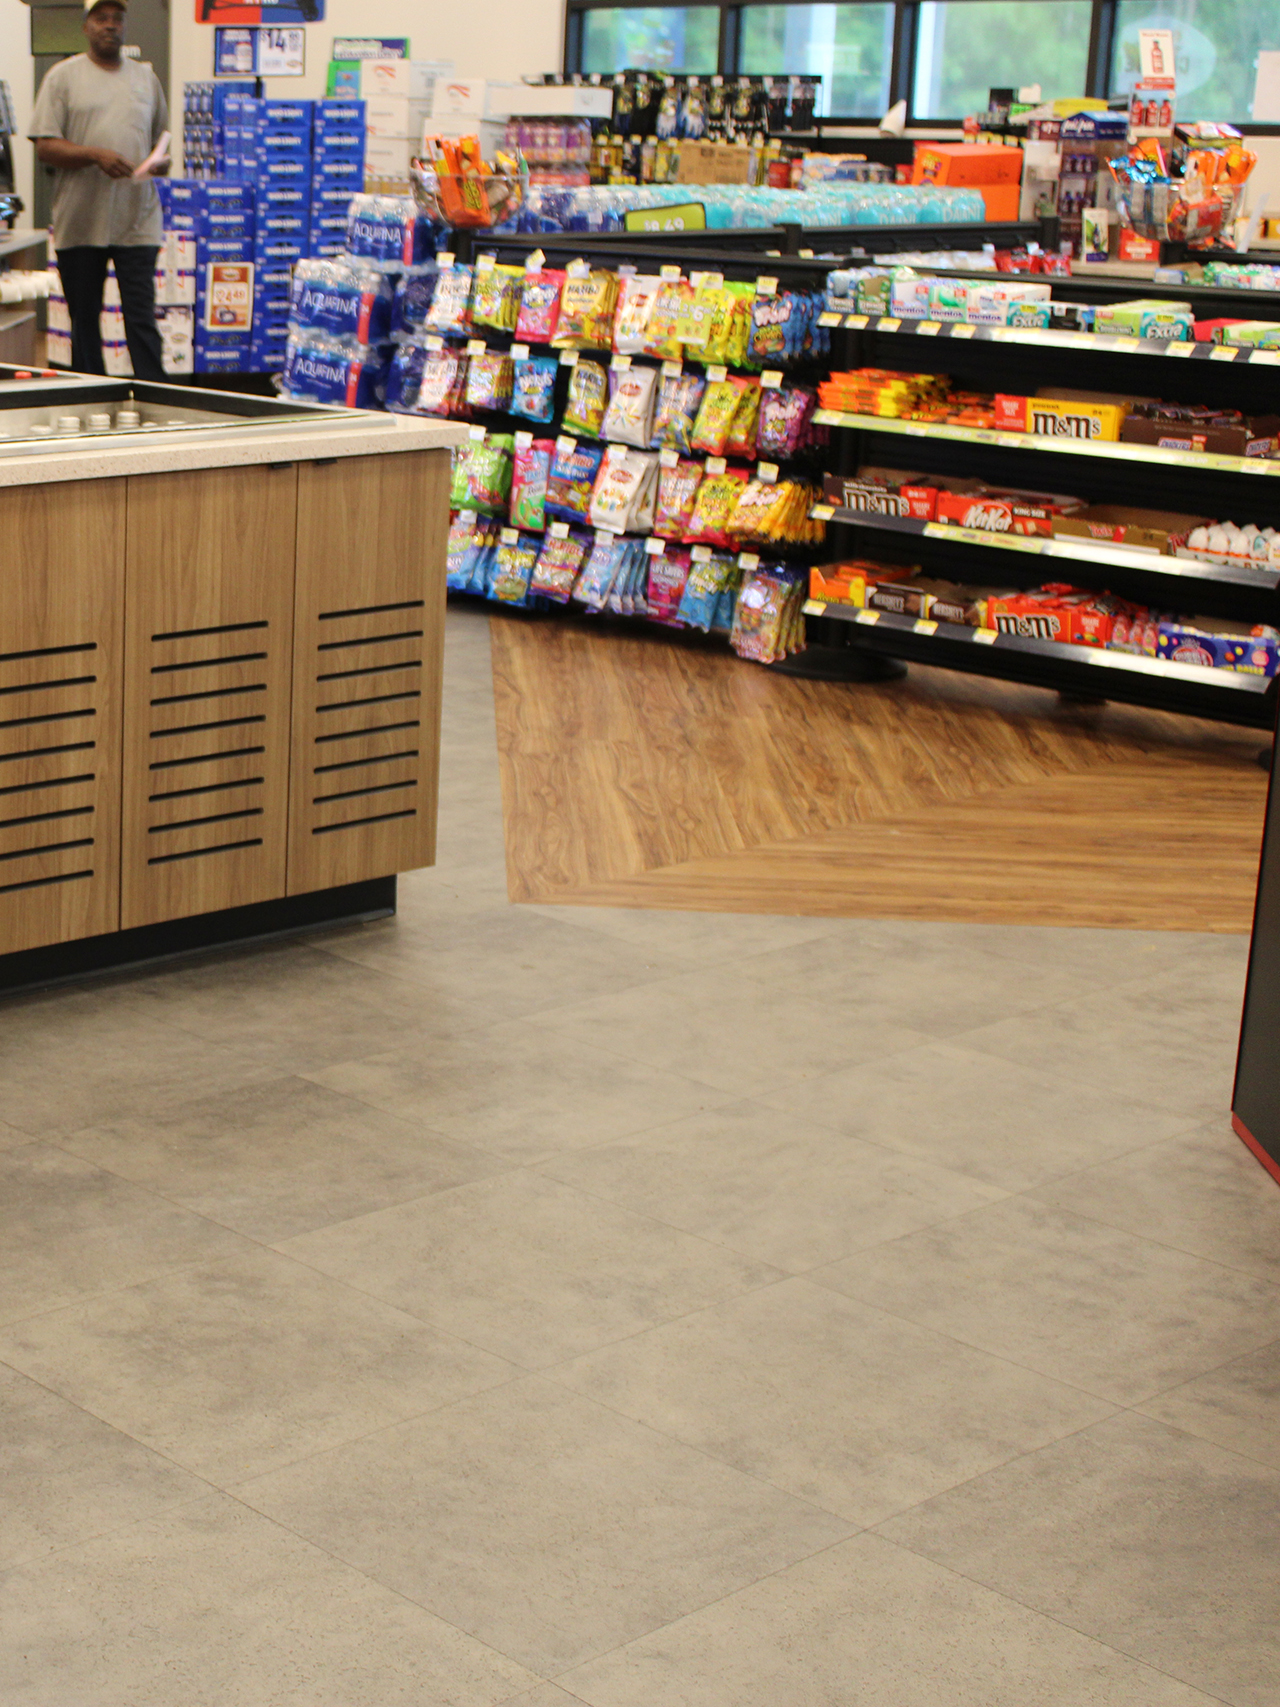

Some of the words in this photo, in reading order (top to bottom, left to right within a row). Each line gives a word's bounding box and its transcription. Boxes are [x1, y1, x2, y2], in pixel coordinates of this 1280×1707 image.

[893, 306, 926, 315] mentos
[931, 309, 963, 318] mentos
[968, 312, 1002, 322] mentos
